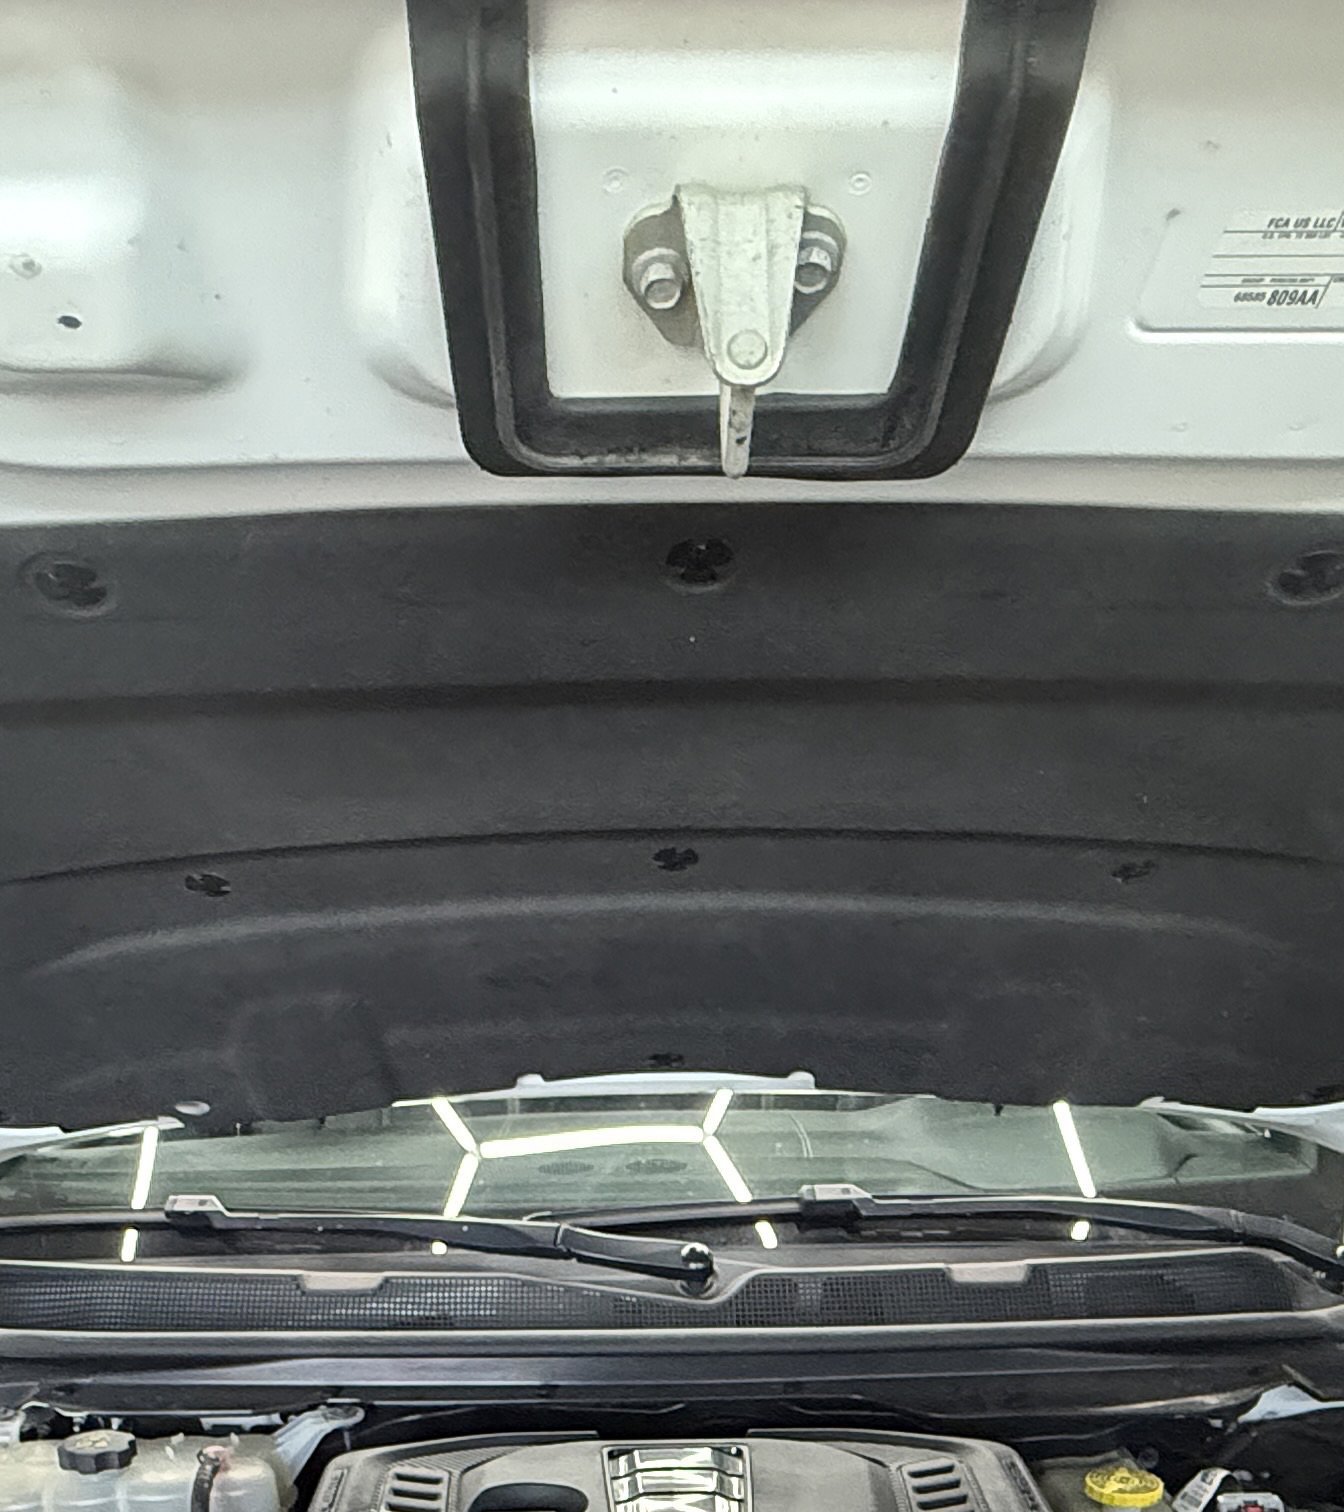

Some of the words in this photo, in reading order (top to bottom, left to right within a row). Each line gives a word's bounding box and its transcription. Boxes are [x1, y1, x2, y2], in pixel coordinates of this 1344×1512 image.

[1267, 217, 1290, 229] FCA
[1293, 217, 1312, 229] US
[1313, 217, 1336, 229] LLC
[1266, 289, 1320, 306] 809AA
